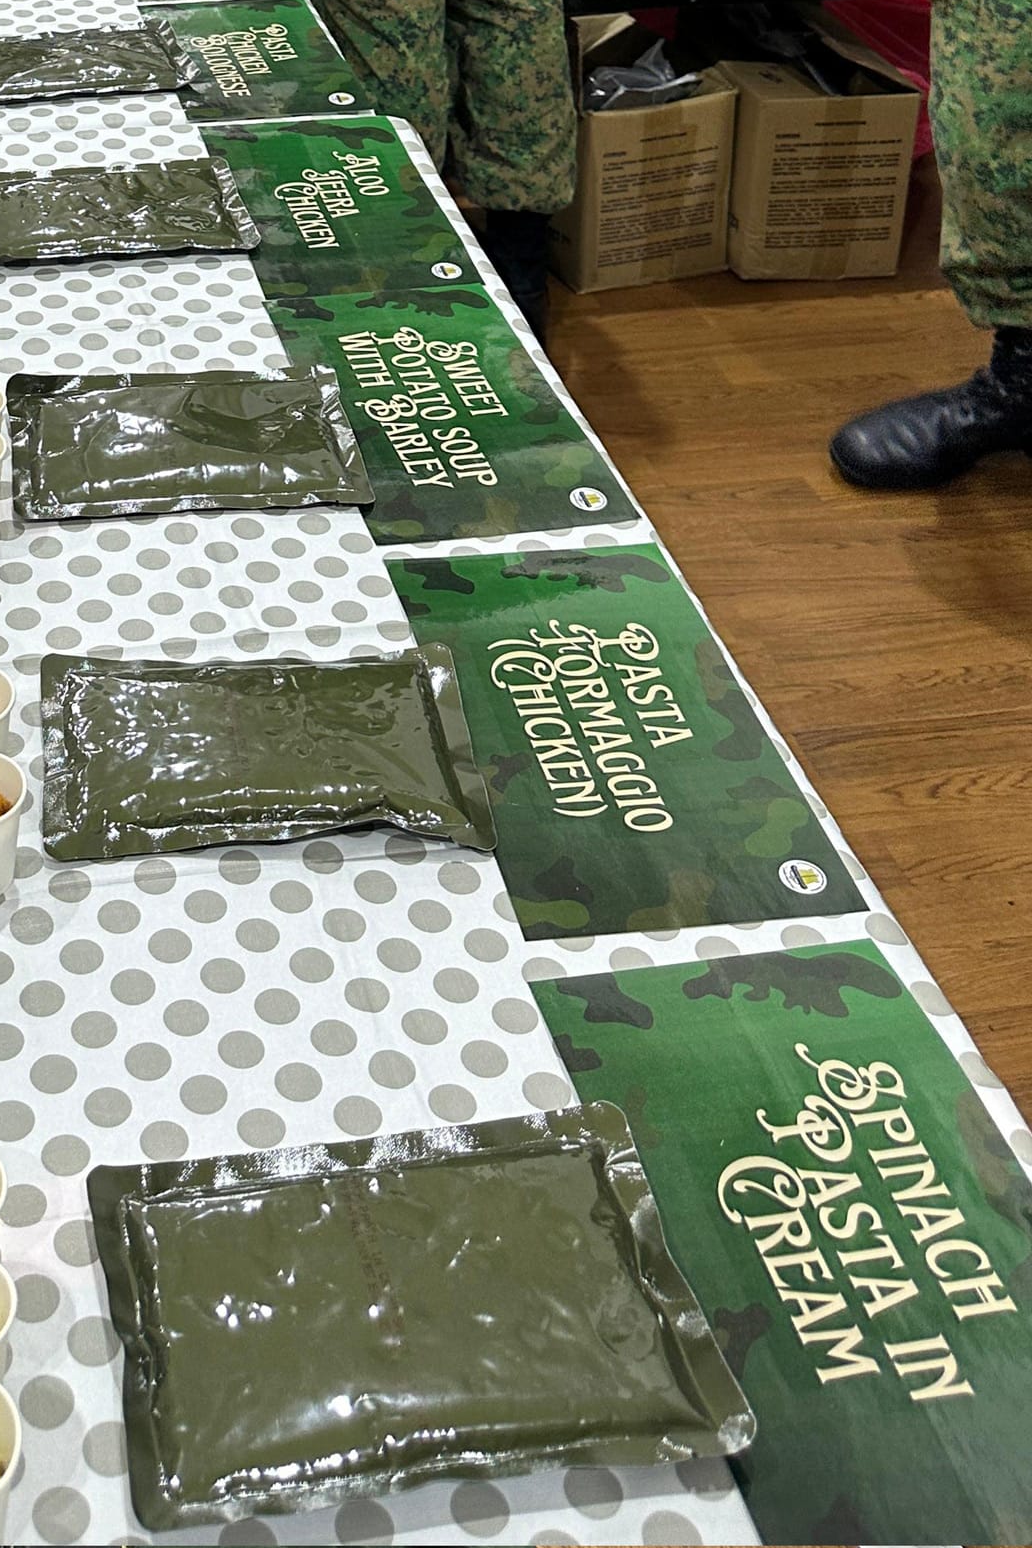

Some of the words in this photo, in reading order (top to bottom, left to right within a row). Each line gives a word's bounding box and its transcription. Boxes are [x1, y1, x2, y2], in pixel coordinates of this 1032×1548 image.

[190, 34, 251, 98] BOLOGNESE
[222, 31, 272, 75] CHICKEN
[249, 23, 298, 61] PASTA
[274, 182, 340, 249] CHICKEN
[301, 168, 360, 218] JEERA
[332, 151, 390, 196] ALOO
[338, 331, 396, 388] WITH
[424, 340, 510, 417] SWEET
[355, 393, 455, 489] BARLEY
[370, 326, 457, 421] POTATO
[432, 427, 498, 486] SOUP
[487, 639, 608, 818] (CHICKEN)
[529, 619, 674, 832] FORMAGGIO
[587, 622, 694, 749] PASTA
[794, 1042, 1019, 1322] SPINACH
[717, 1155, 882, 1385] CREAM
[756, 1094, 919, 1319] PASTA
[883, 1332, 976, 1402] IN
